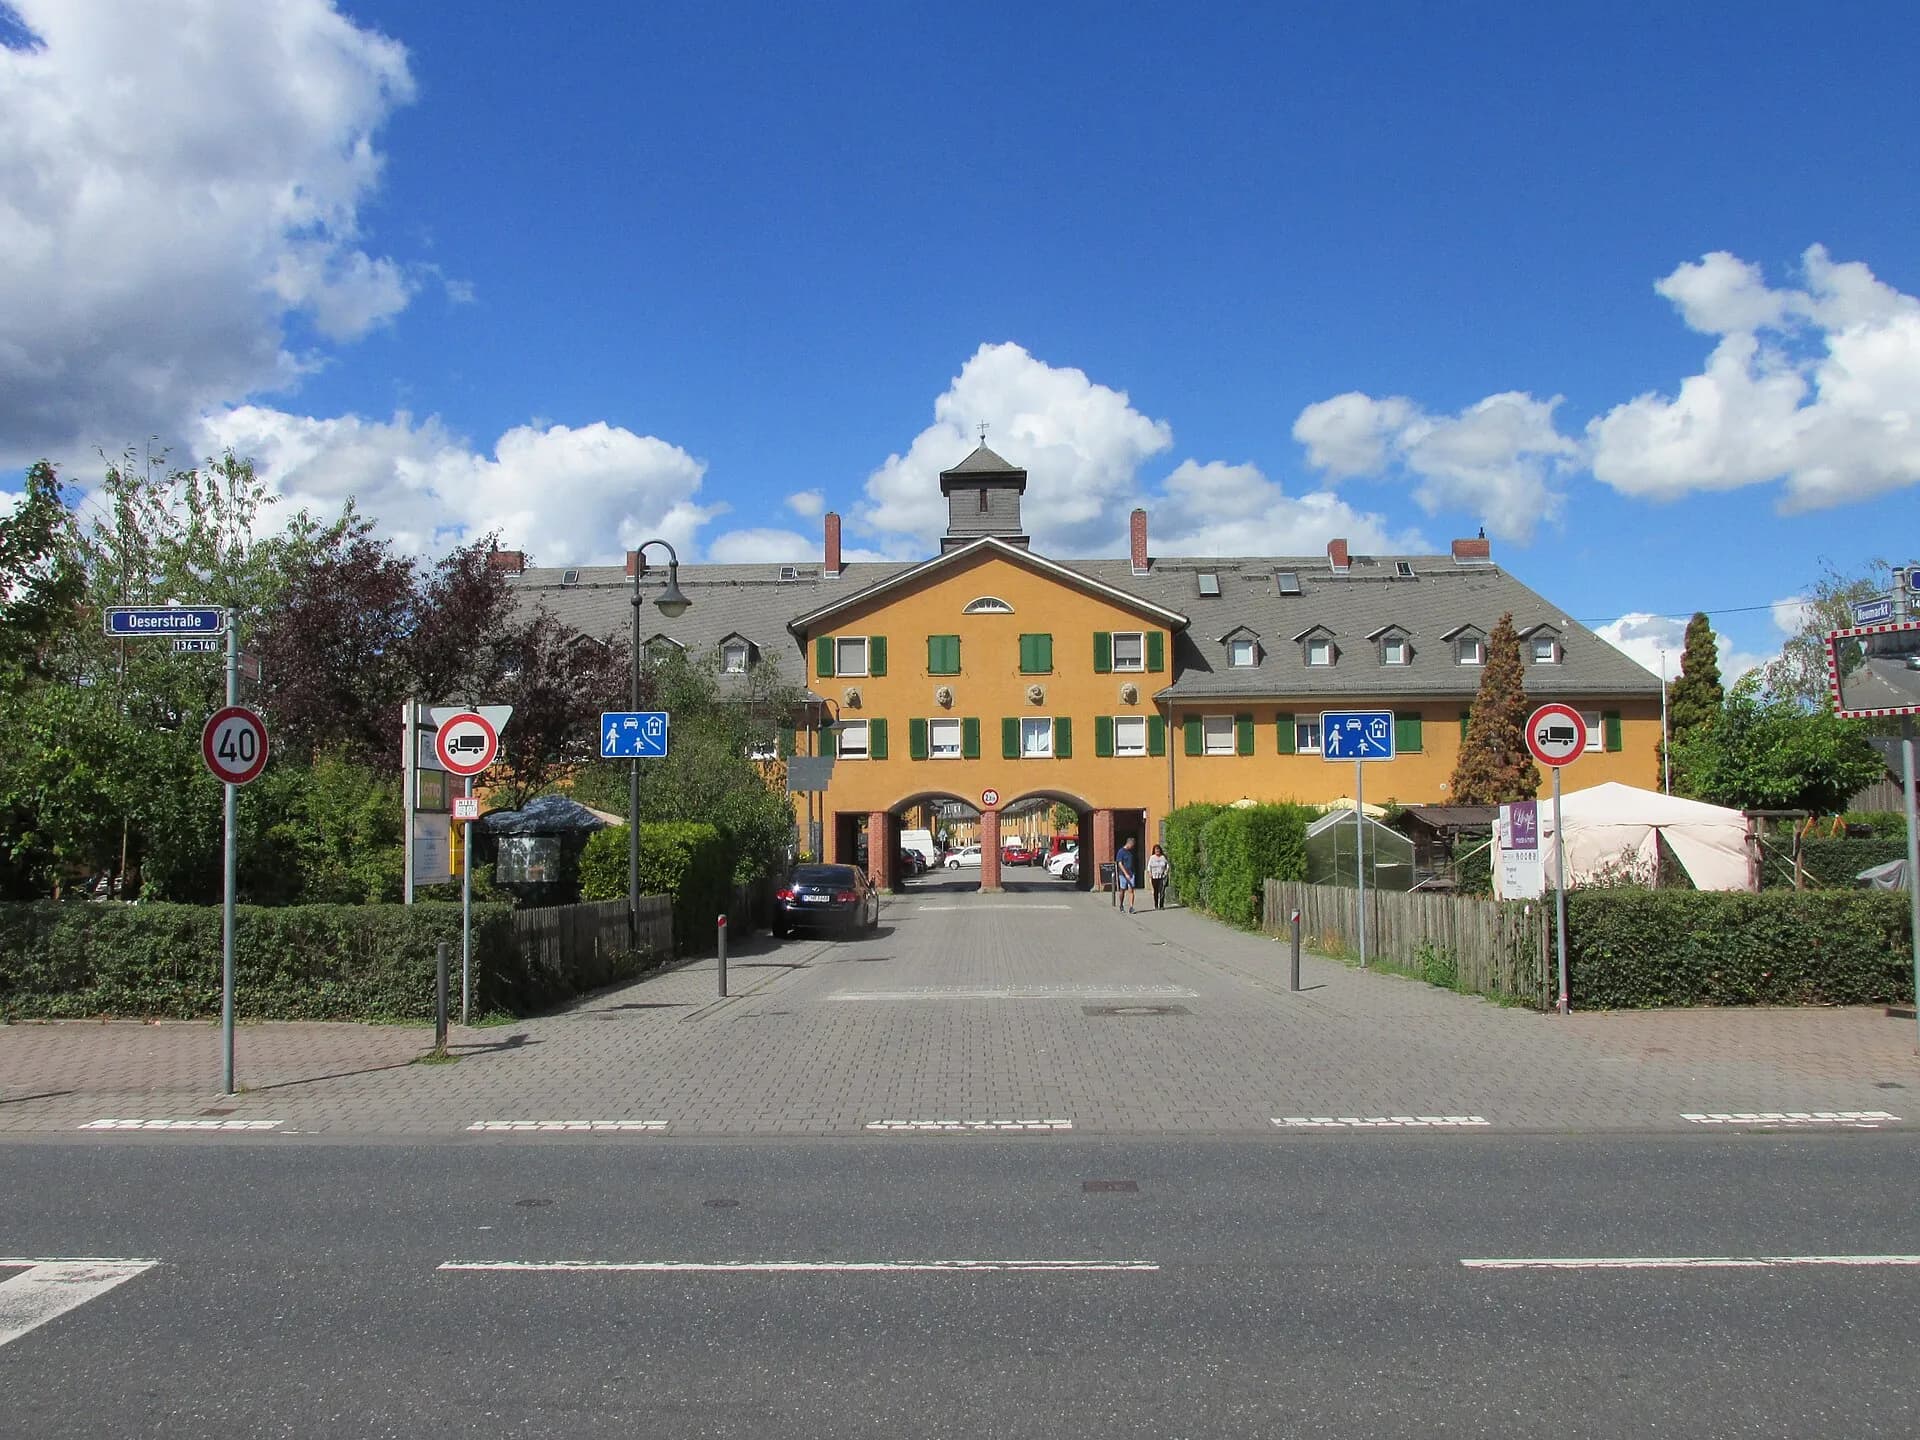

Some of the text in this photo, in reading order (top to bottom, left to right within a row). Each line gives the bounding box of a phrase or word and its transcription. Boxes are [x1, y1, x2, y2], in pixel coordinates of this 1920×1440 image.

[1858, 603, 1888, 621] Neumarkt
[129, 614, 202, 628] Oeserstraße
[176, 641, 216, 651] 136-140
[218, 728, 255, 762] 40
